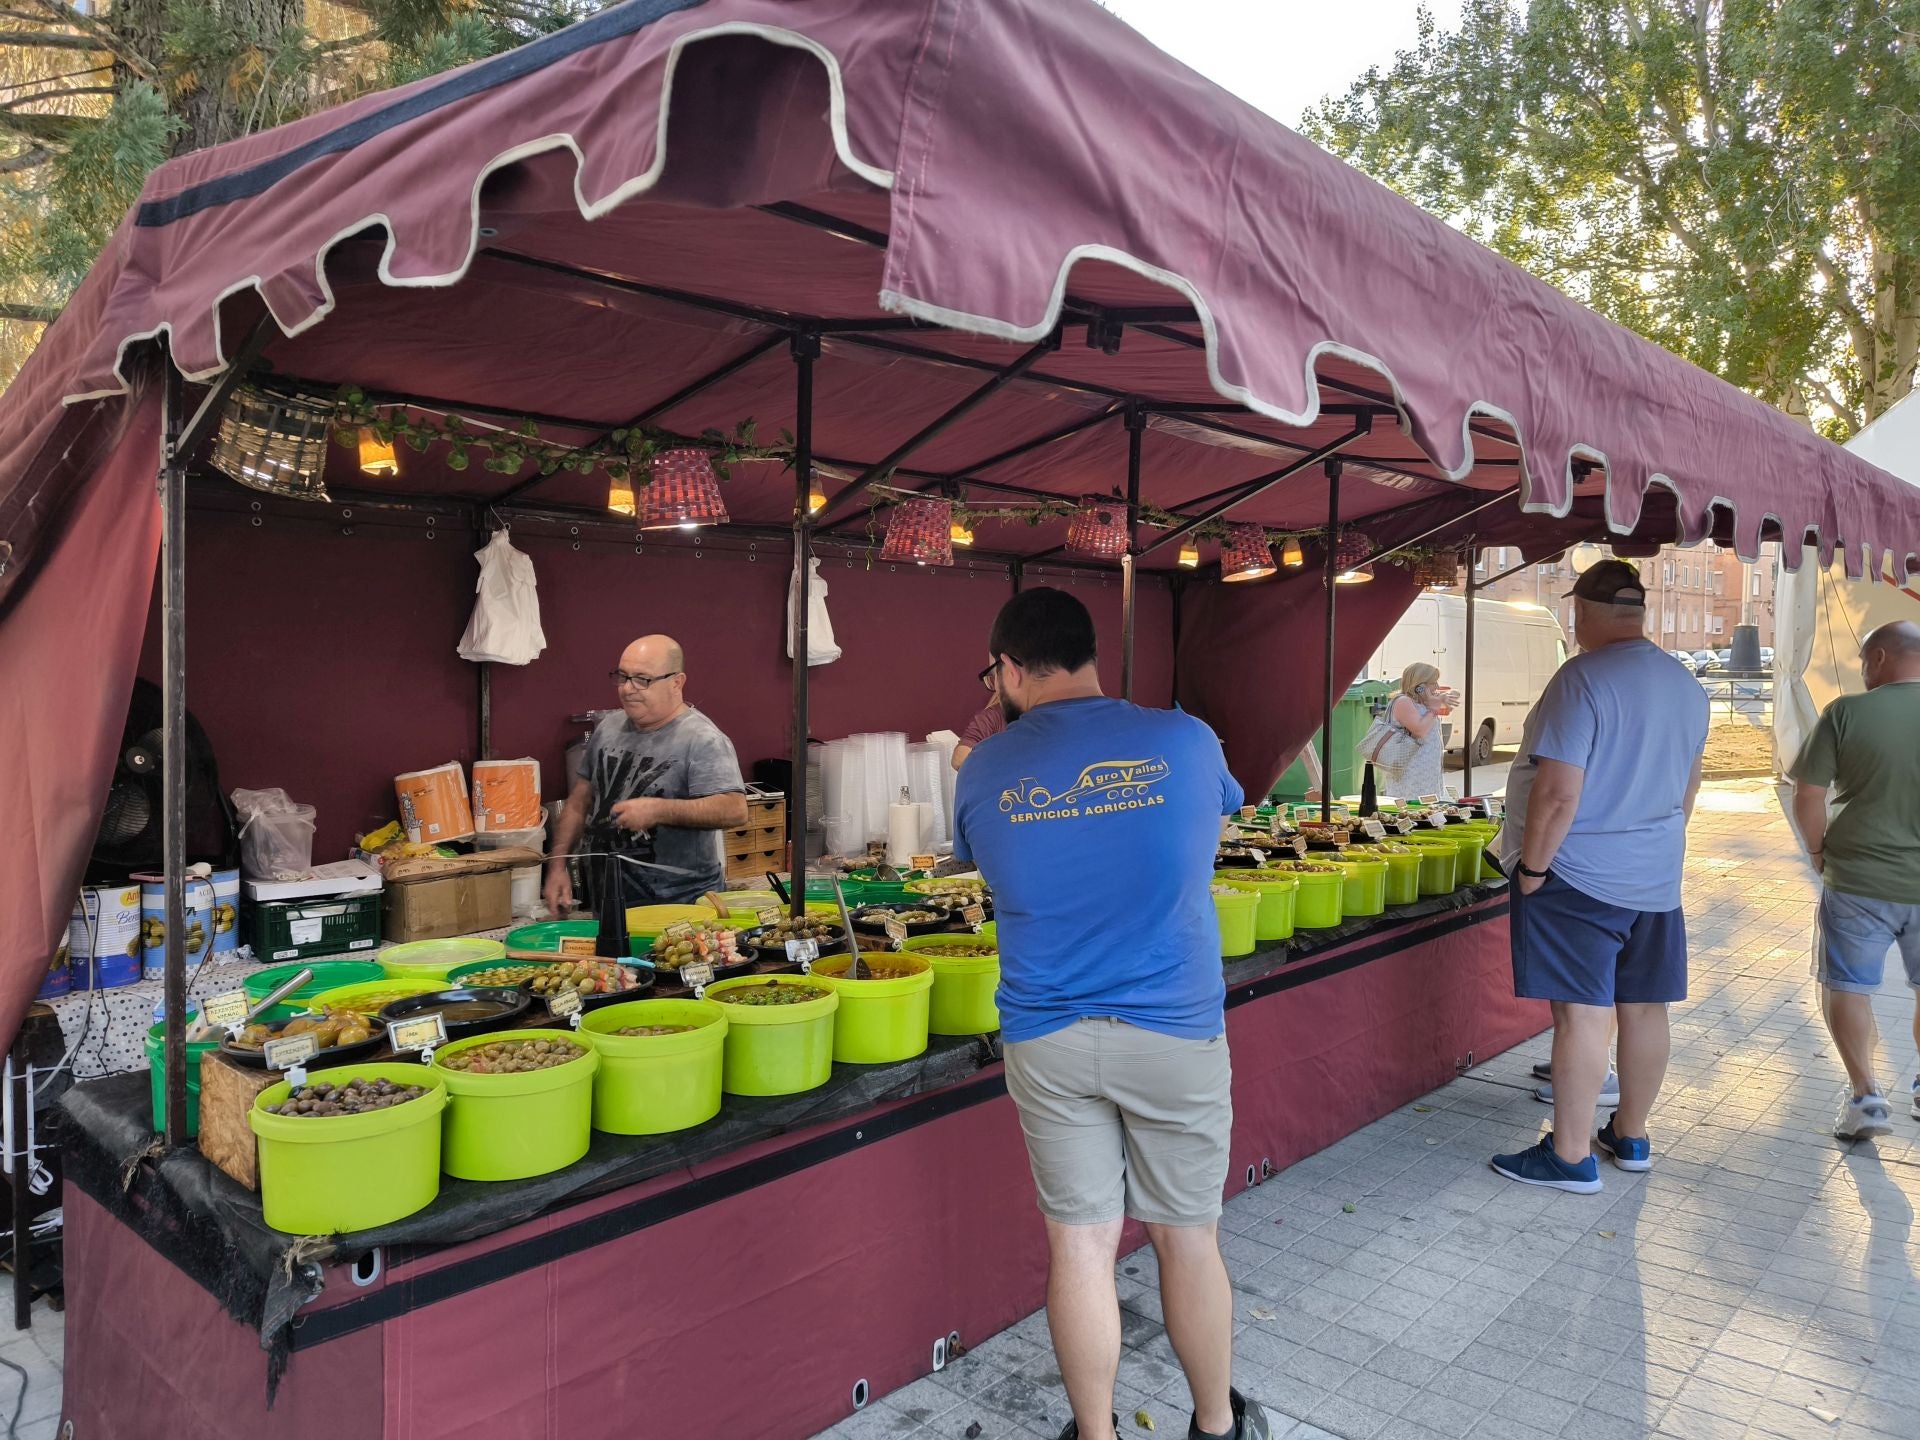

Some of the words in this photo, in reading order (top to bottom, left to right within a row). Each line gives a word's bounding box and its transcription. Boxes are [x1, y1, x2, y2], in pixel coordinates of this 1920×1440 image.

[1080, 771, 1119, 789] Agro
[1120, 763, 1165, 782] Valles
[1010, 807, 1080, 823] SERVICIOS
[1085, 794, 1165, 816] AGRICOLAS
